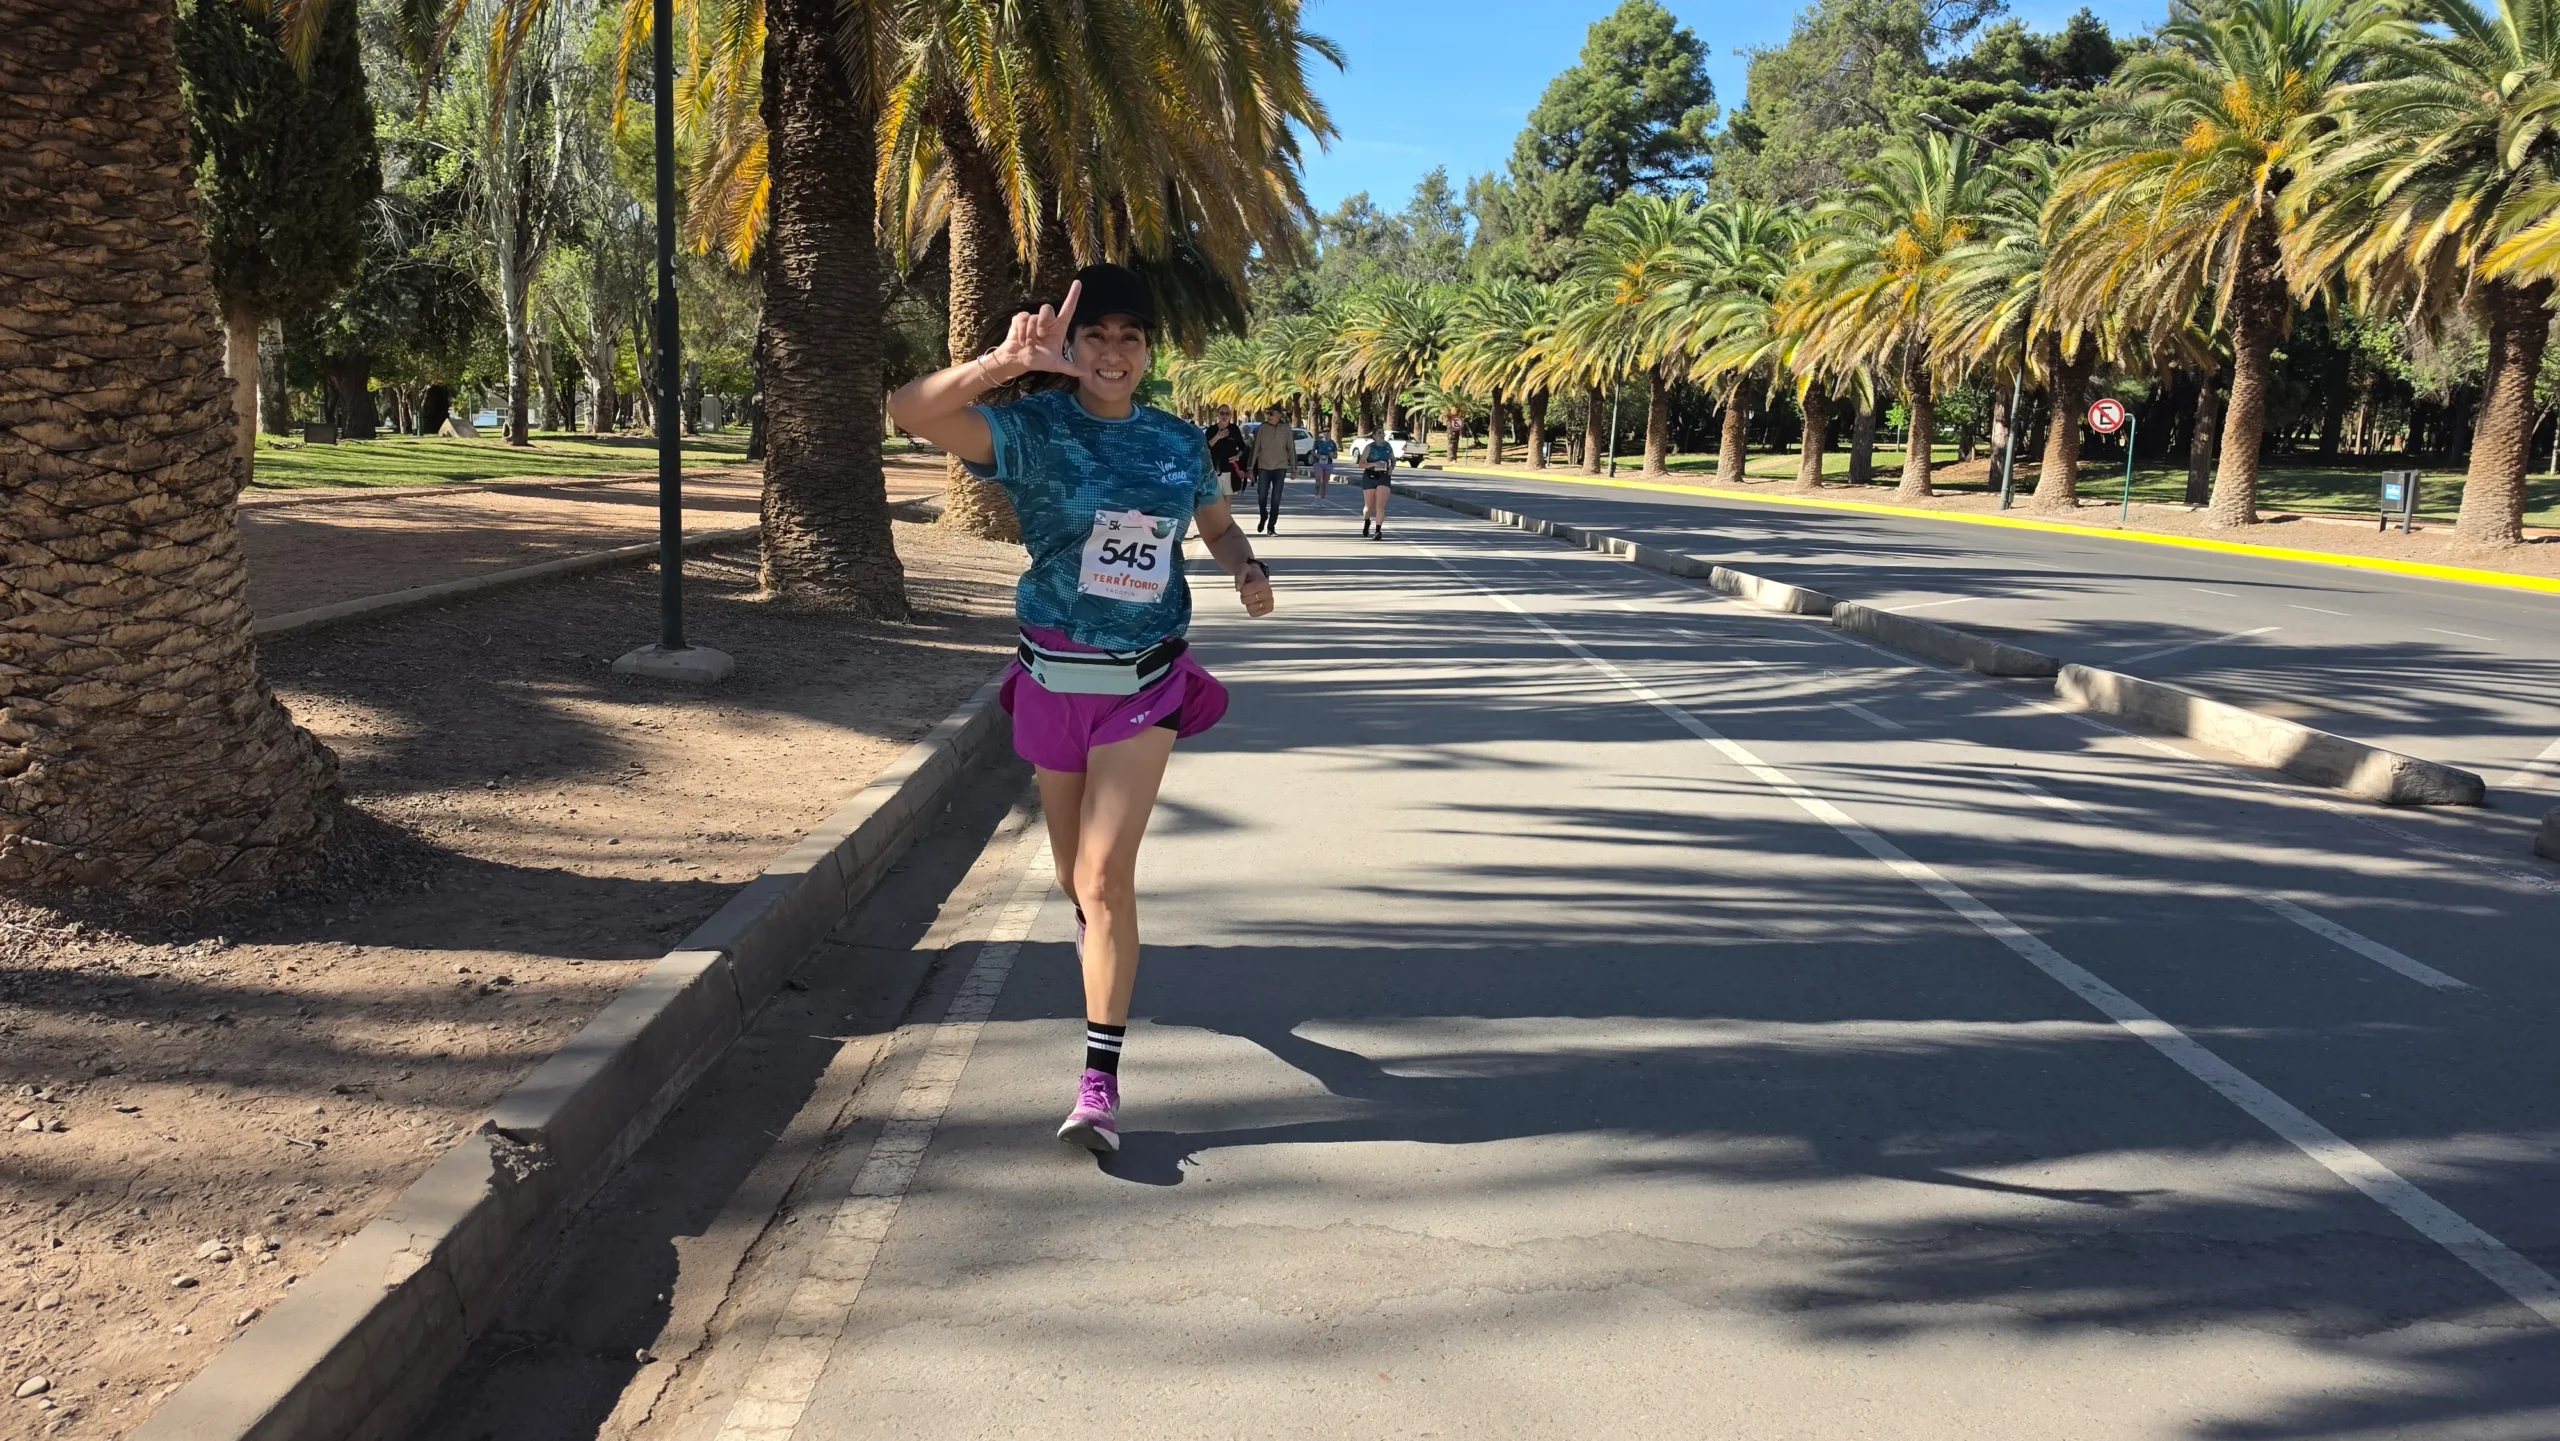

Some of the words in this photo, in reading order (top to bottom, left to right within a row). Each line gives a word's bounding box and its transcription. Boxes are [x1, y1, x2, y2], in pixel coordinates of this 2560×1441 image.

[2100, 406, 2112, 425] E
[1098, 538, 1158, 571] 545
[1093, 572, 1159, 591] TERRITORIO
